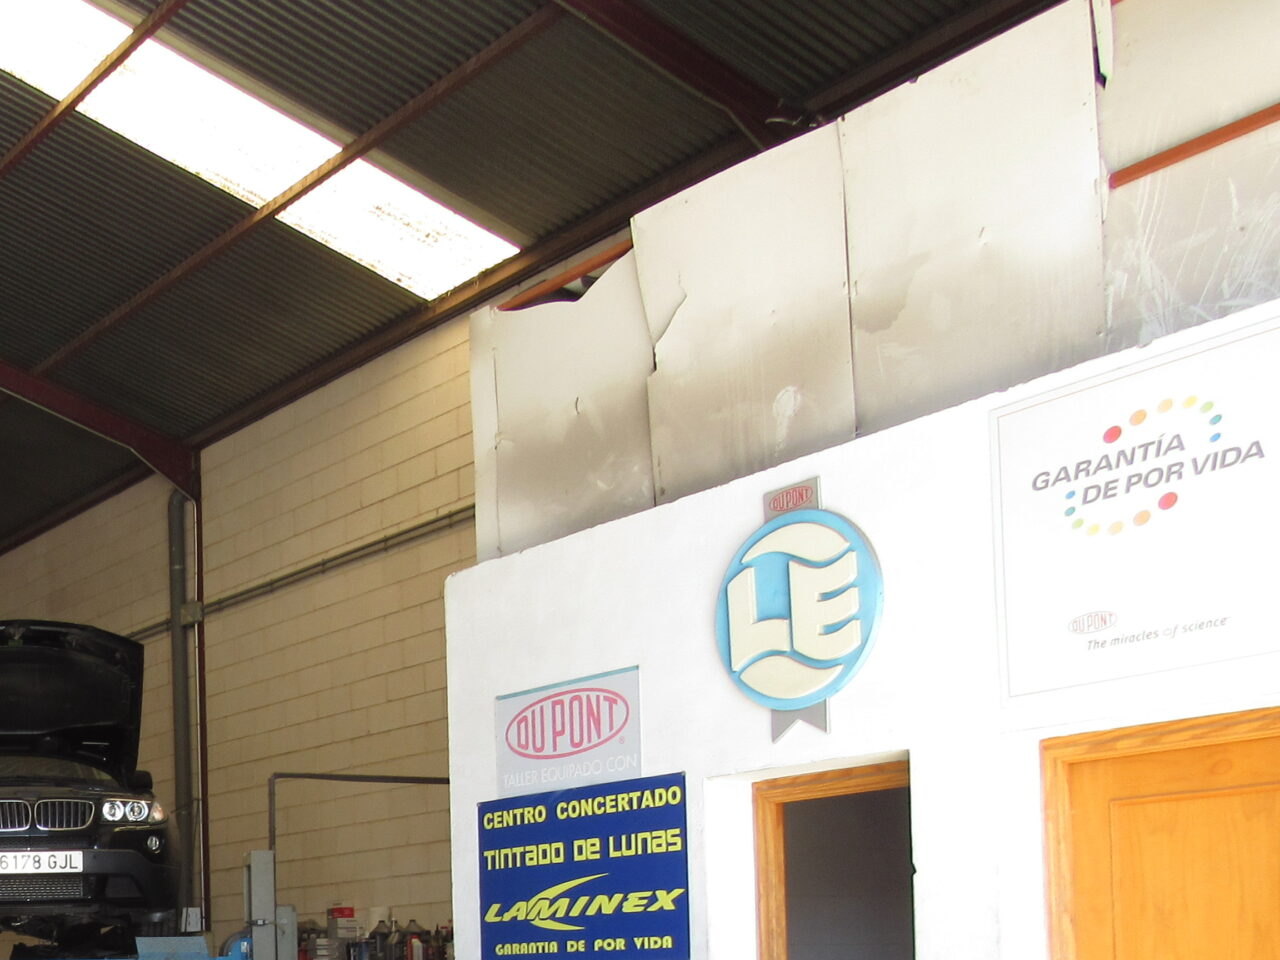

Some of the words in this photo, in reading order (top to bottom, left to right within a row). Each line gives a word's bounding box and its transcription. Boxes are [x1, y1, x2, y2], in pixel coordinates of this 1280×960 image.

[1031, 432, 1186, 492] GARANTÍA
[1081, 478, 1120, 506] DE
[1124, 461, 1185, 495] POR
[1191, 440, 1266, 476] VIDA
[1087, 638, 1108, 651] The
[1110, 629, 1159, 646] miracles
[1162, 623, 1179, 640] of
[1182, 616, 1228, 633] science
[502, 770, 539, 789] TALLER
[541, 758, 602, 782] EQUIPADO
[606, 753, 638, 773] CON
[483, 804, 547, 830] CENTRO
[556, 786, 682, 820] CONCERTADO
[0, 854, 42, 870] 6178
[47, 854, 79, 870] GJL
[483, 841, 565, 871] TINTADO
[574, 837, 601, 862] DE
[608, 828, 683, 859] LUNAS
[483, 887, 686, 923] LAMINEX
[495, 940, 558, 956] GARANTIA
[567, 939, 586, 953] DE
[594, 937, 626, 951] POR
[634, 935, 673, 950] VIDA
